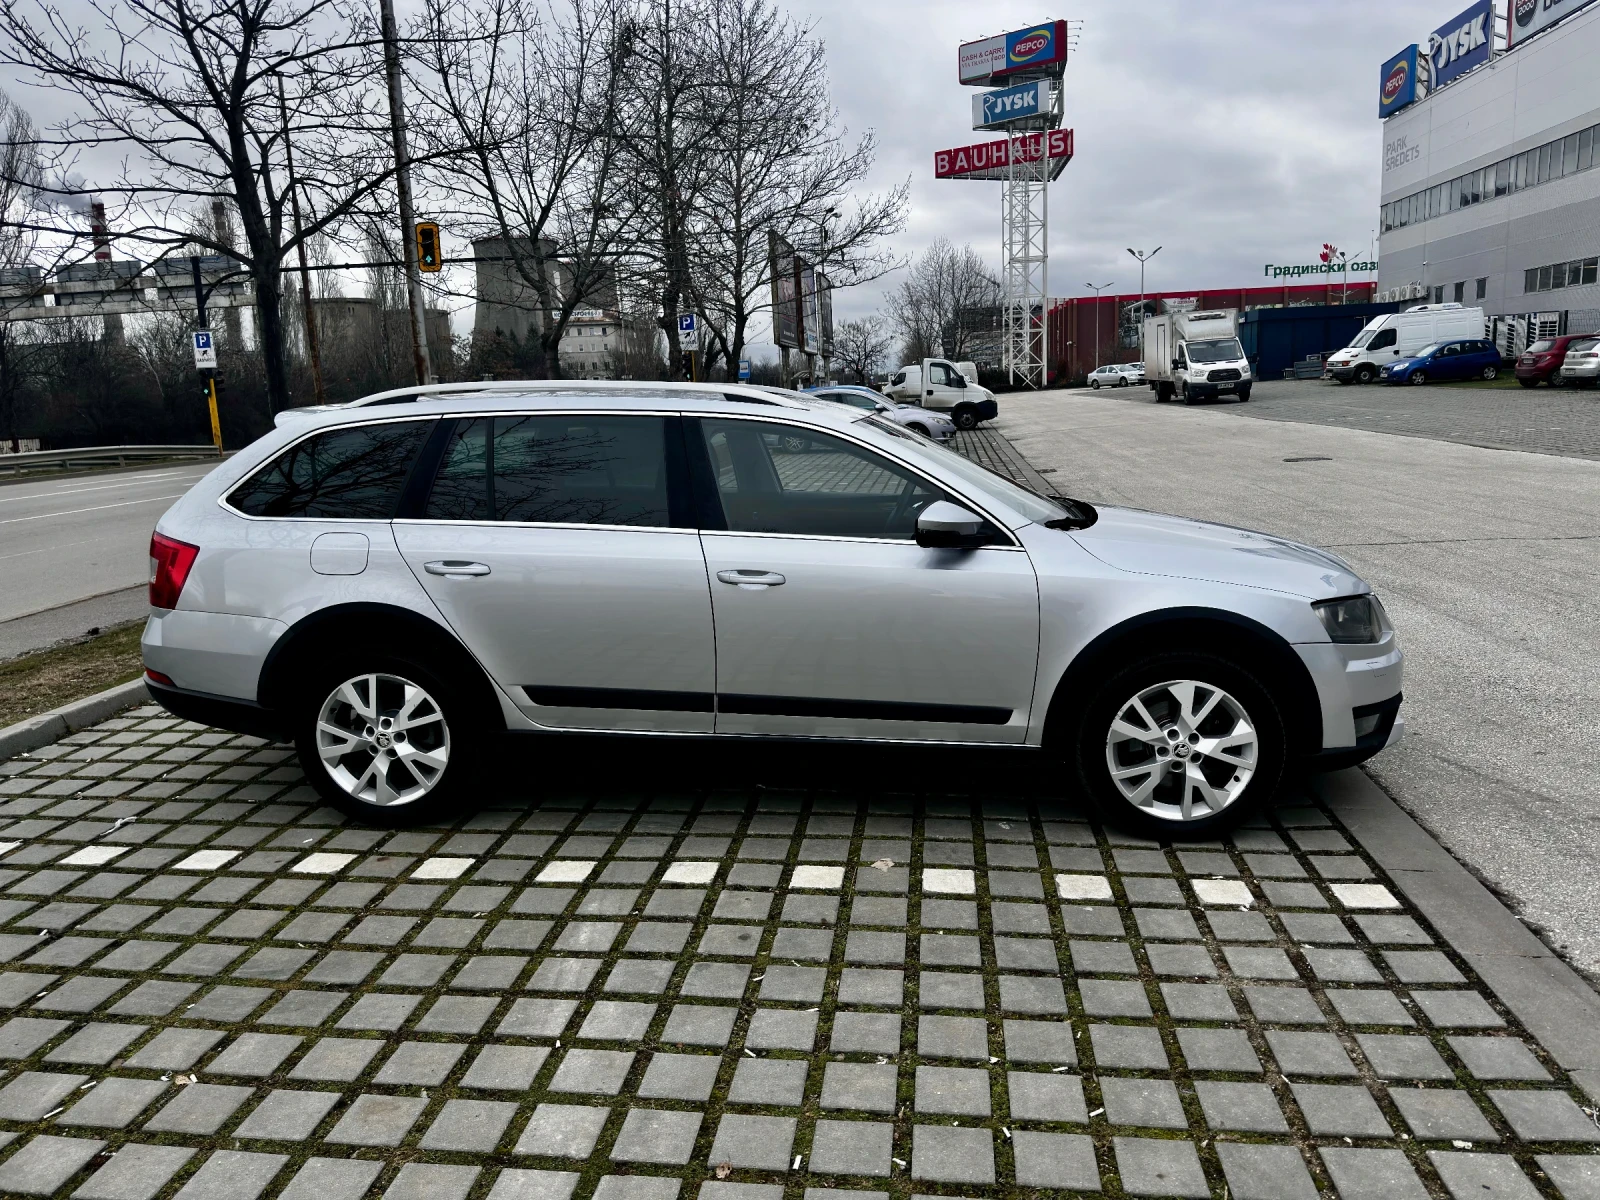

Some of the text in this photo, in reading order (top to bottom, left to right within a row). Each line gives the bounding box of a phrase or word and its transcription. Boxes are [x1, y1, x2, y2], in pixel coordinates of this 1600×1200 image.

[1015, 38, 1045, 54] PEPCO
[1438, 13, 1487, 68] JYSK
[961, 53, 979, 63] CASH
[984, 46, 1005, 57] CARRY
[1385, 72, 1404, 94] PEPCO
[994, 90, 1036, 114] JYSK
[937, 133, 1065, 173] BAUHAUS
[1386, 135, 1408, 158] PARK
[1385, 144, 1420, 172] SREDETS
[1264, 263, 1346, 278] Градински
[682, 316, 691, 329] P
[198, 335, 207, 347] P
